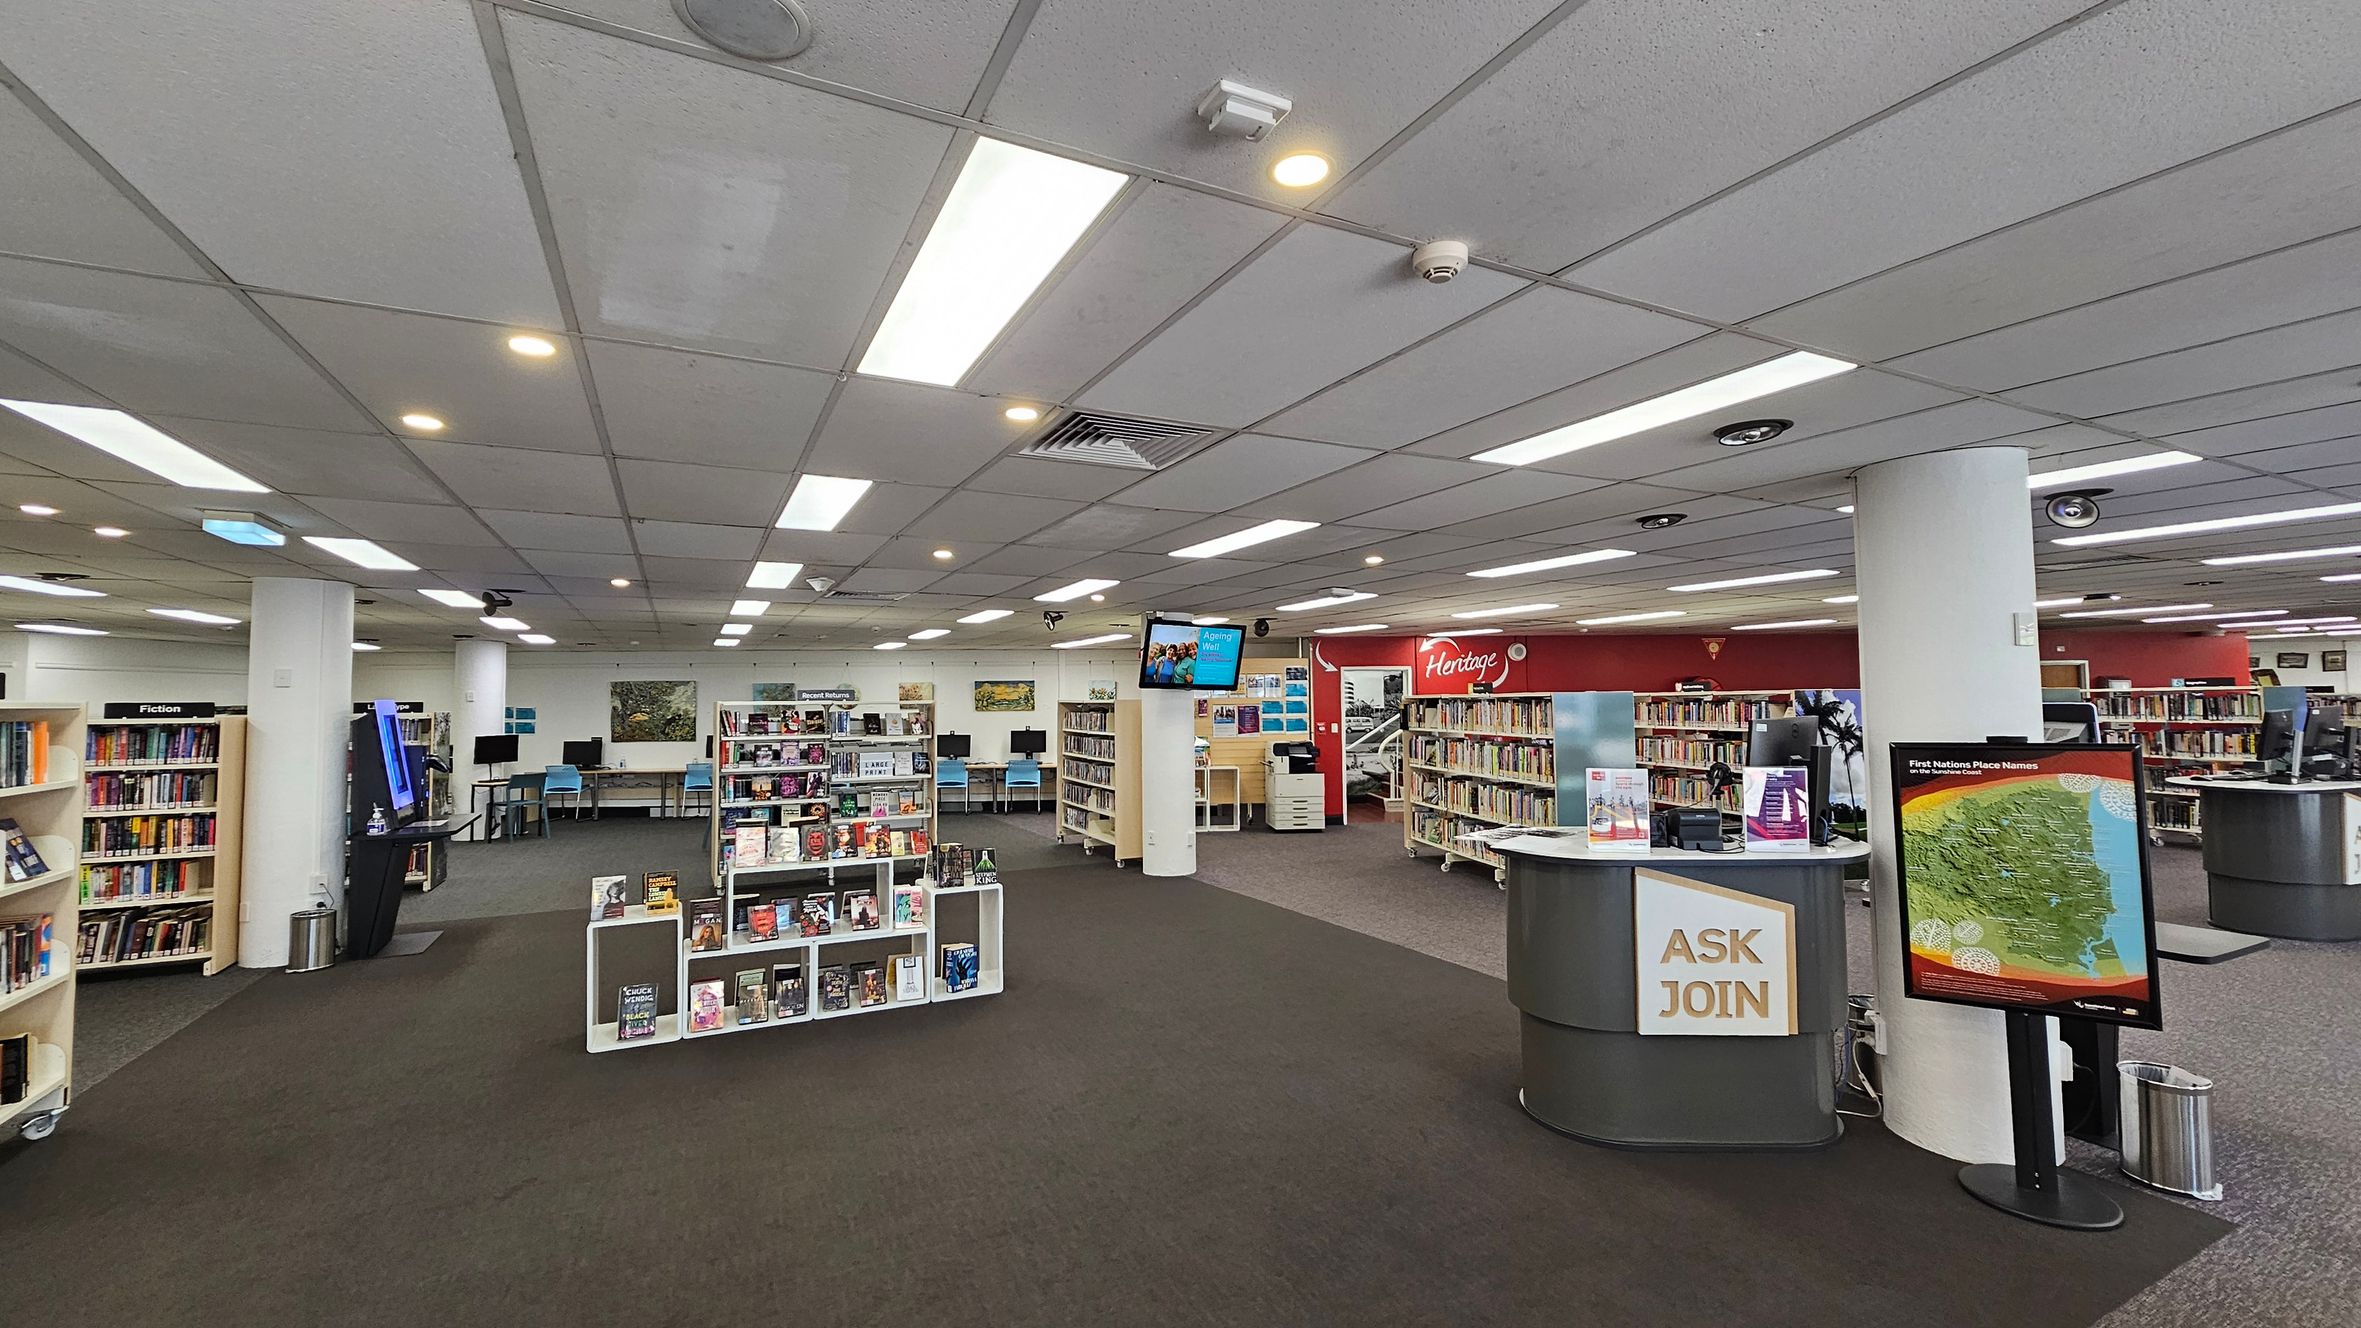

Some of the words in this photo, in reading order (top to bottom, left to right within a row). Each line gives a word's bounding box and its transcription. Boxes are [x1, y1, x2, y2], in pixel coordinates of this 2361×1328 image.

[1203, 631, 1232, 642] Ageing
[1202, 643, 1220, 651] Well
[1425, 650, 1498, 681] Heritage
[139, 705, 182, 714] Fiction
[1909, 760, 1932, 768] First
[1933, 760, 1971, 769] Nations
[1973, 761, 2001, 769] Place
[2002, 761, 2039, 770] Names
[976, 876, 998, 885] KING
[1660, 928, 1763, 965] ASK
[625, 987, 652, 996] CHUCK
[624, 995, 654, 1005] WENDIG
[1658, 980, 1770, 1019] JOIN
